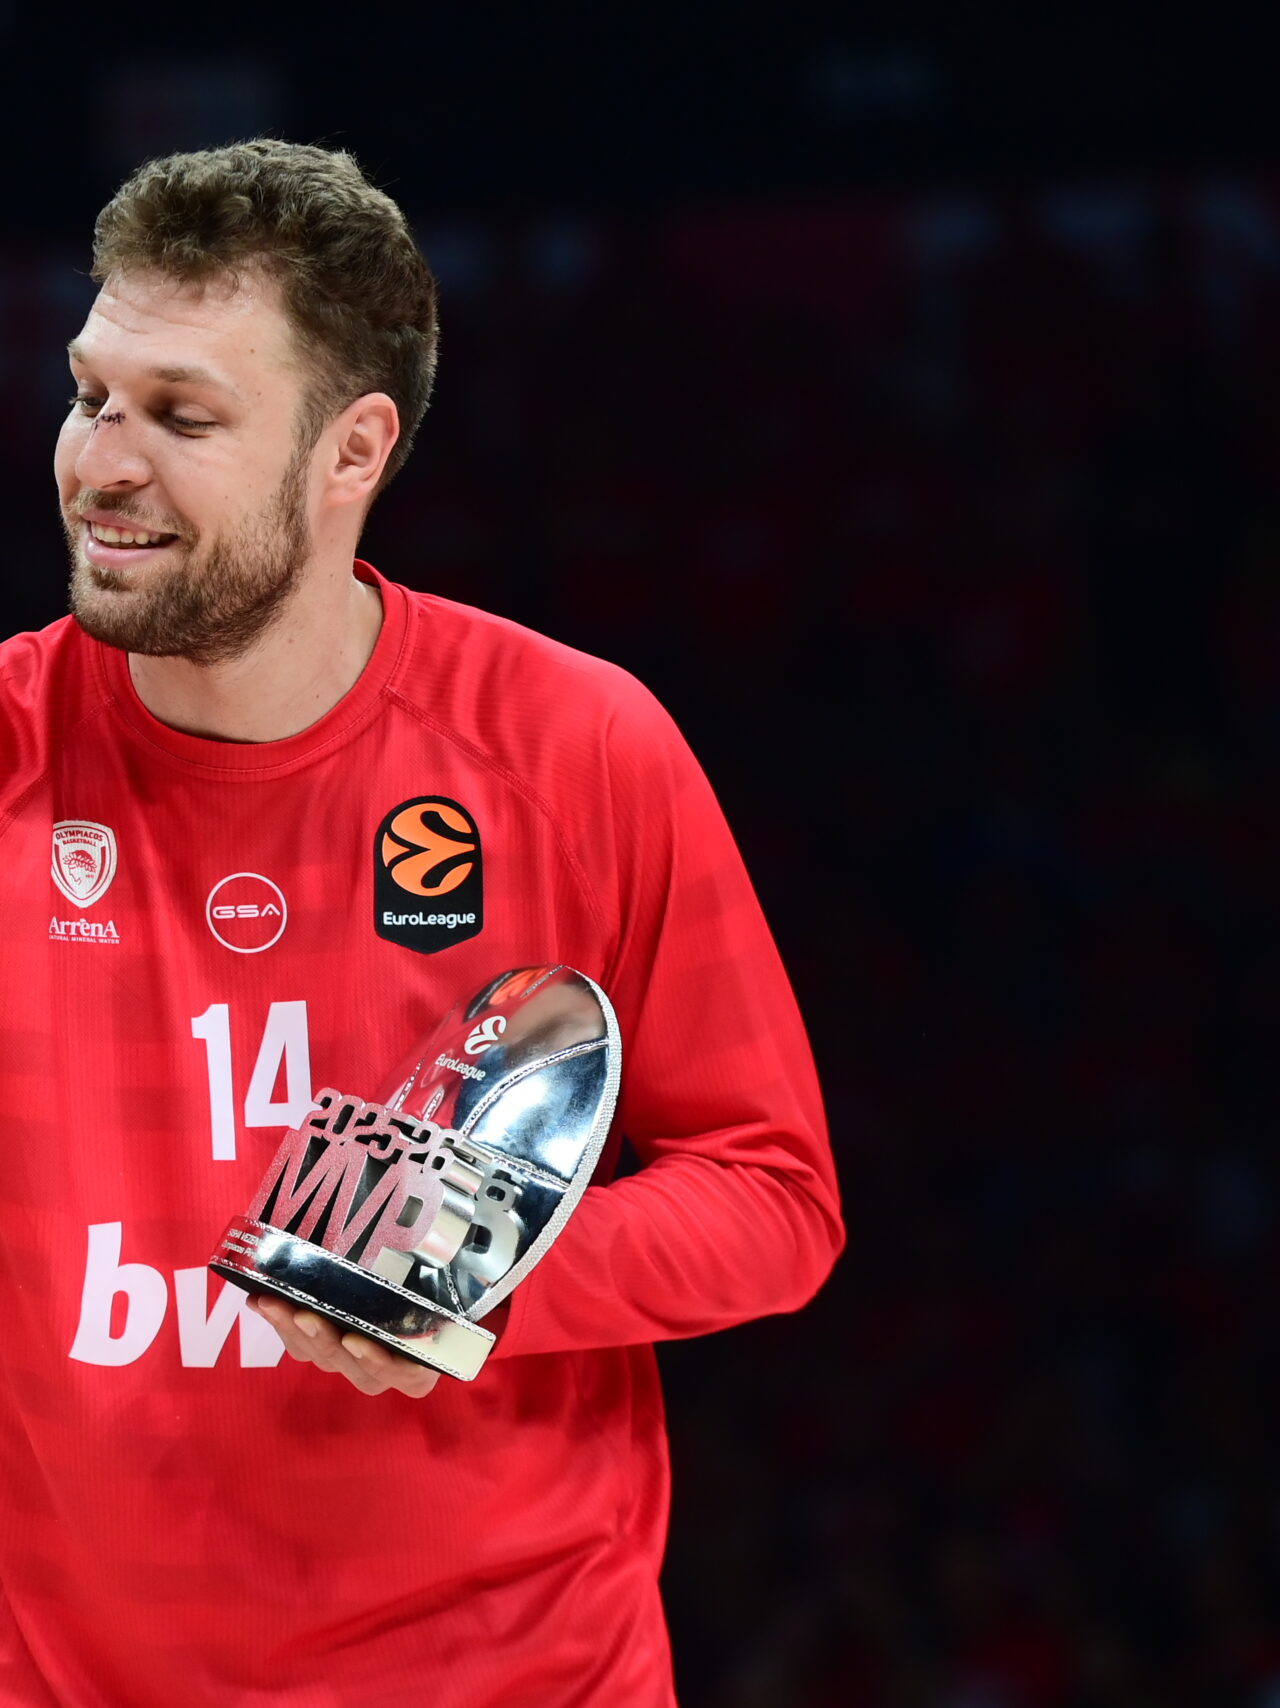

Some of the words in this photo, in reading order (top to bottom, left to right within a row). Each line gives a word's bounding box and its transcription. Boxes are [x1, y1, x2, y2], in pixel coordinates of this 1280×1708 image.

[55, 829, 103, 842] OLYMPIACOS
[62, 838, 97, 847] BASKETBALL
[213, 903, 281, 919] GSA
[383, 912, 476, 929] EuroLeague
[435, 1053, 486, 1081] EuroLeague
[190, 1000, 320, 1161] 14
[246, 1130, 445, 1272] MVP
[68, 1221, 286, 1369] bw
